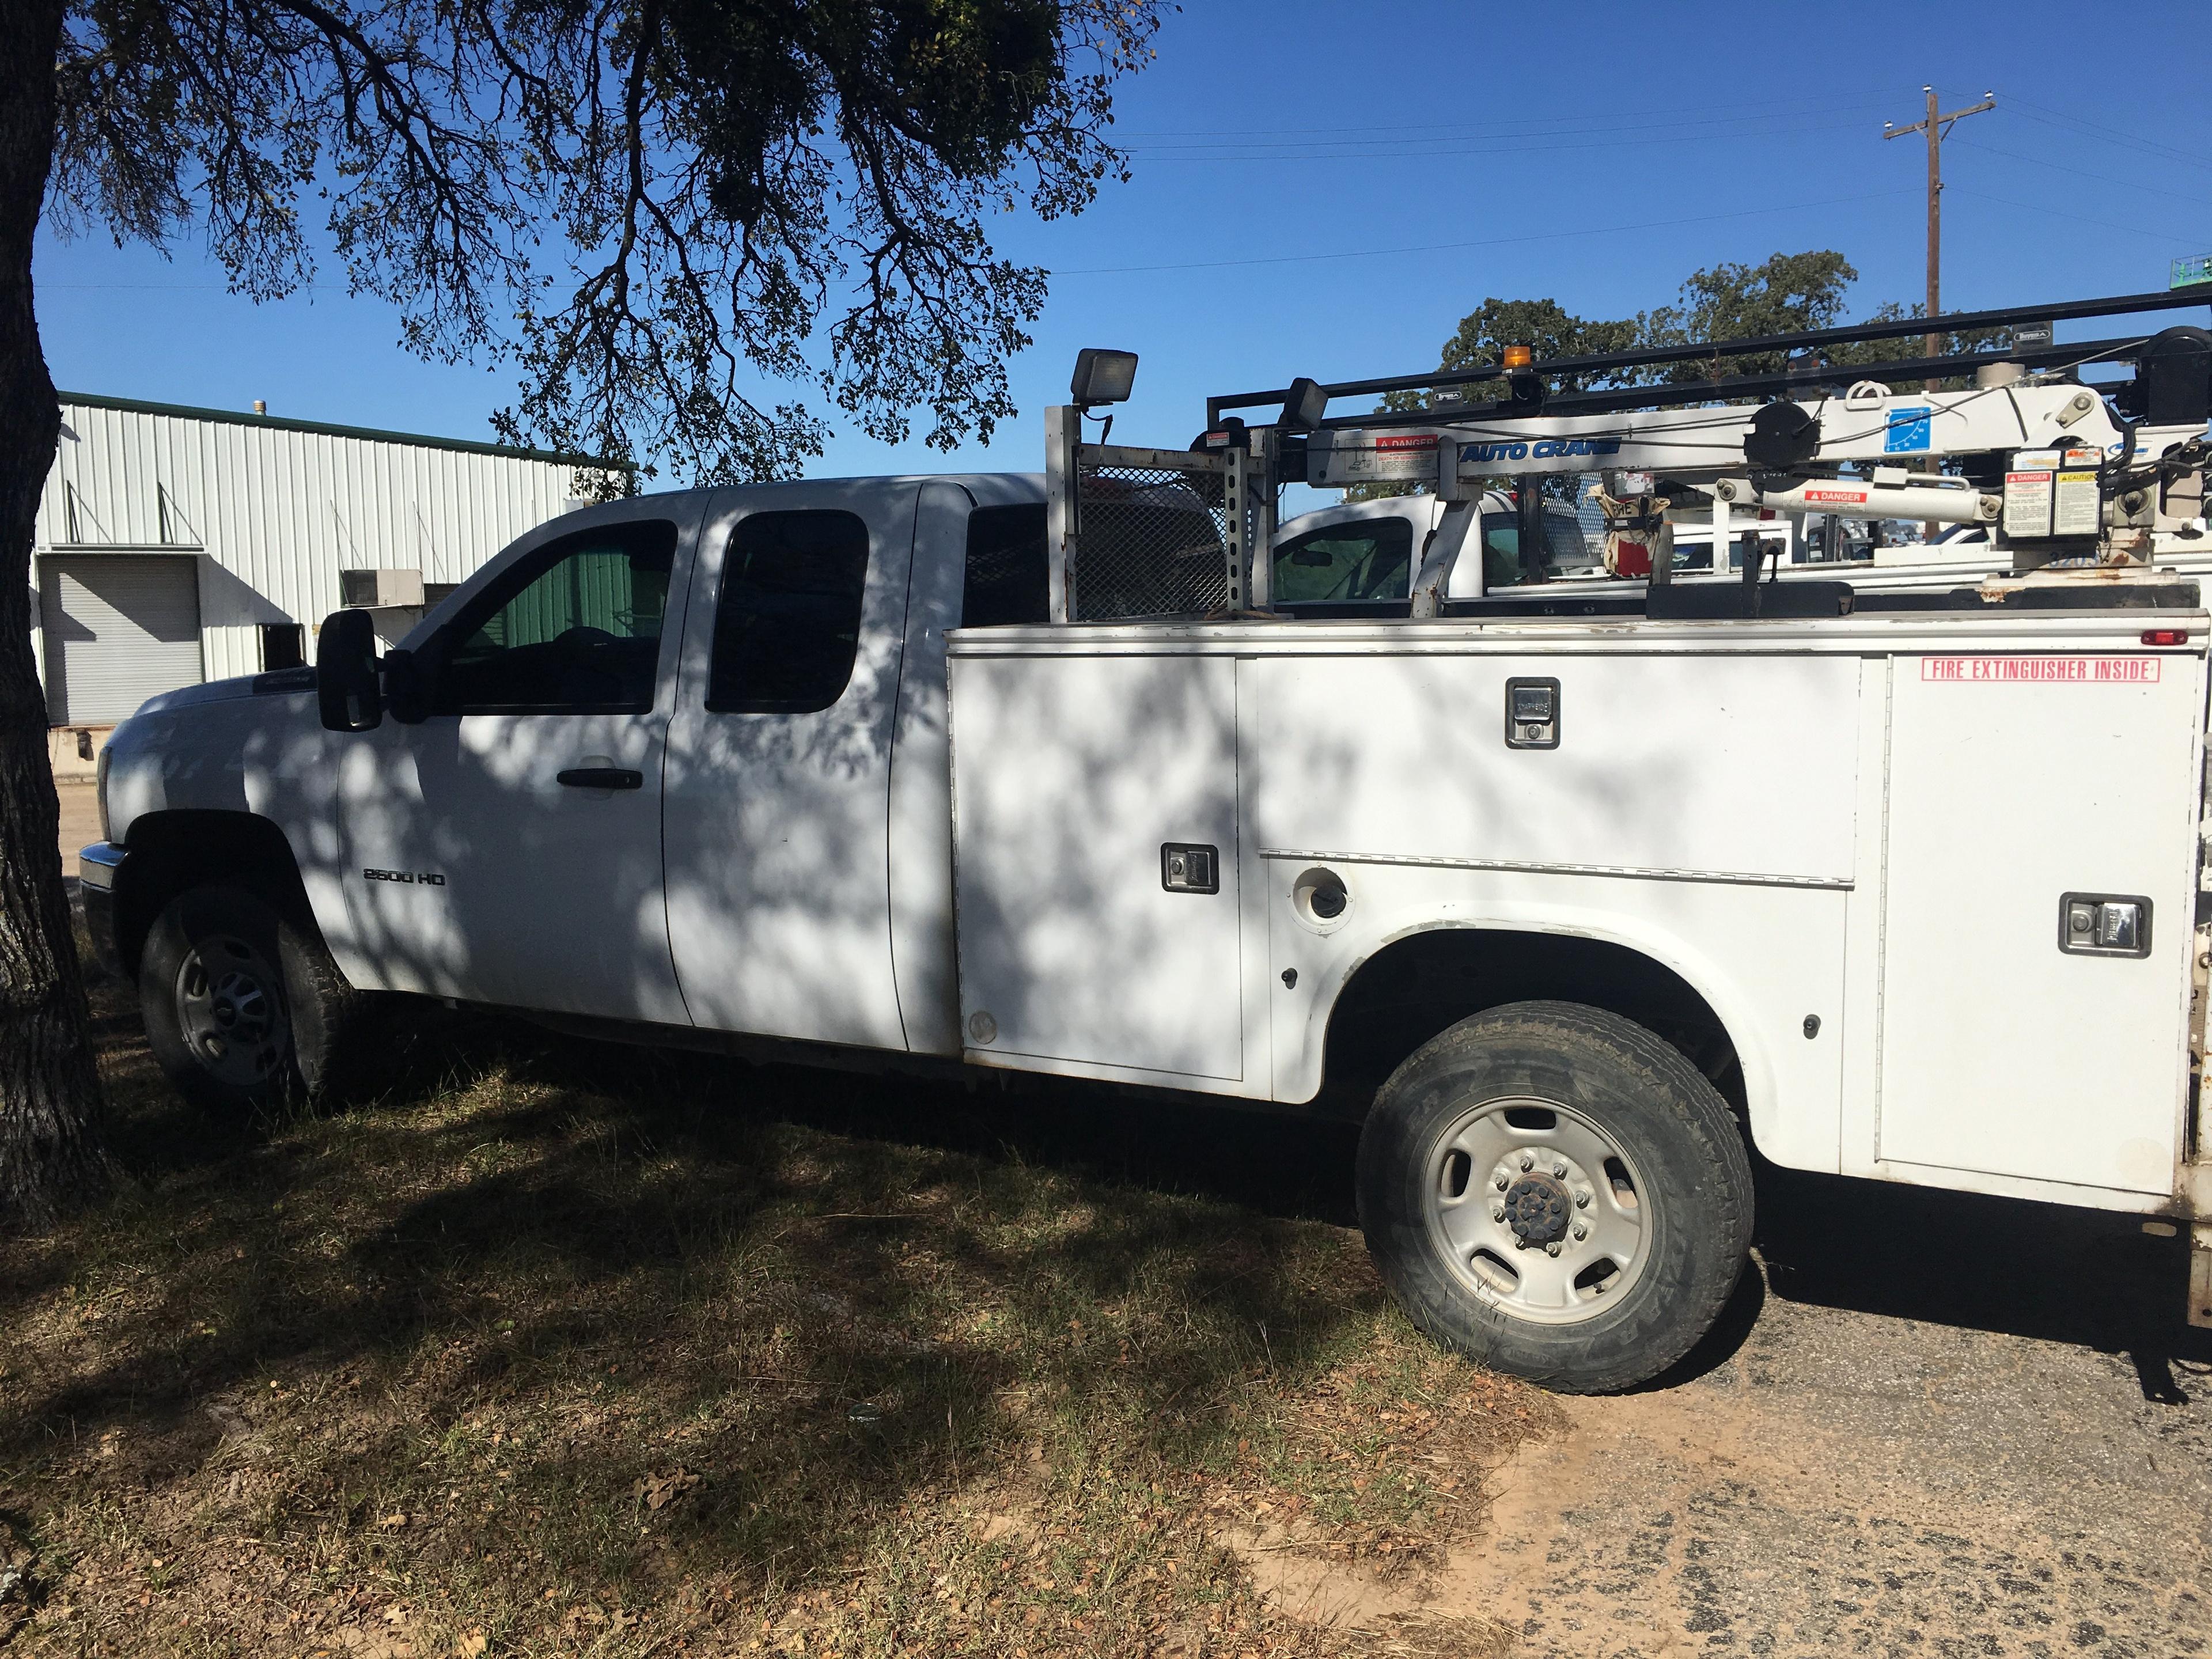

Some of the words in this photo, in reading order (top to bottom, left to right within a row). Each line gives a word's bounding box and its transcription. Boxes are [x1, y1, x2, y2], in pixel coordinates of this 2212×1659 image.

[1460, 442, 1528, 463] AUTO
[1821, 492, 1861, 501] DANGER
[1932, 661, 1964, 679] FIRE
[1972, 661, 2086, 679] EXTINGUISHER
[2094, 661, 2149, 680] INSIDE
[363, 868, 414, 884] 2500
[418, 873, 446, 886] HD
